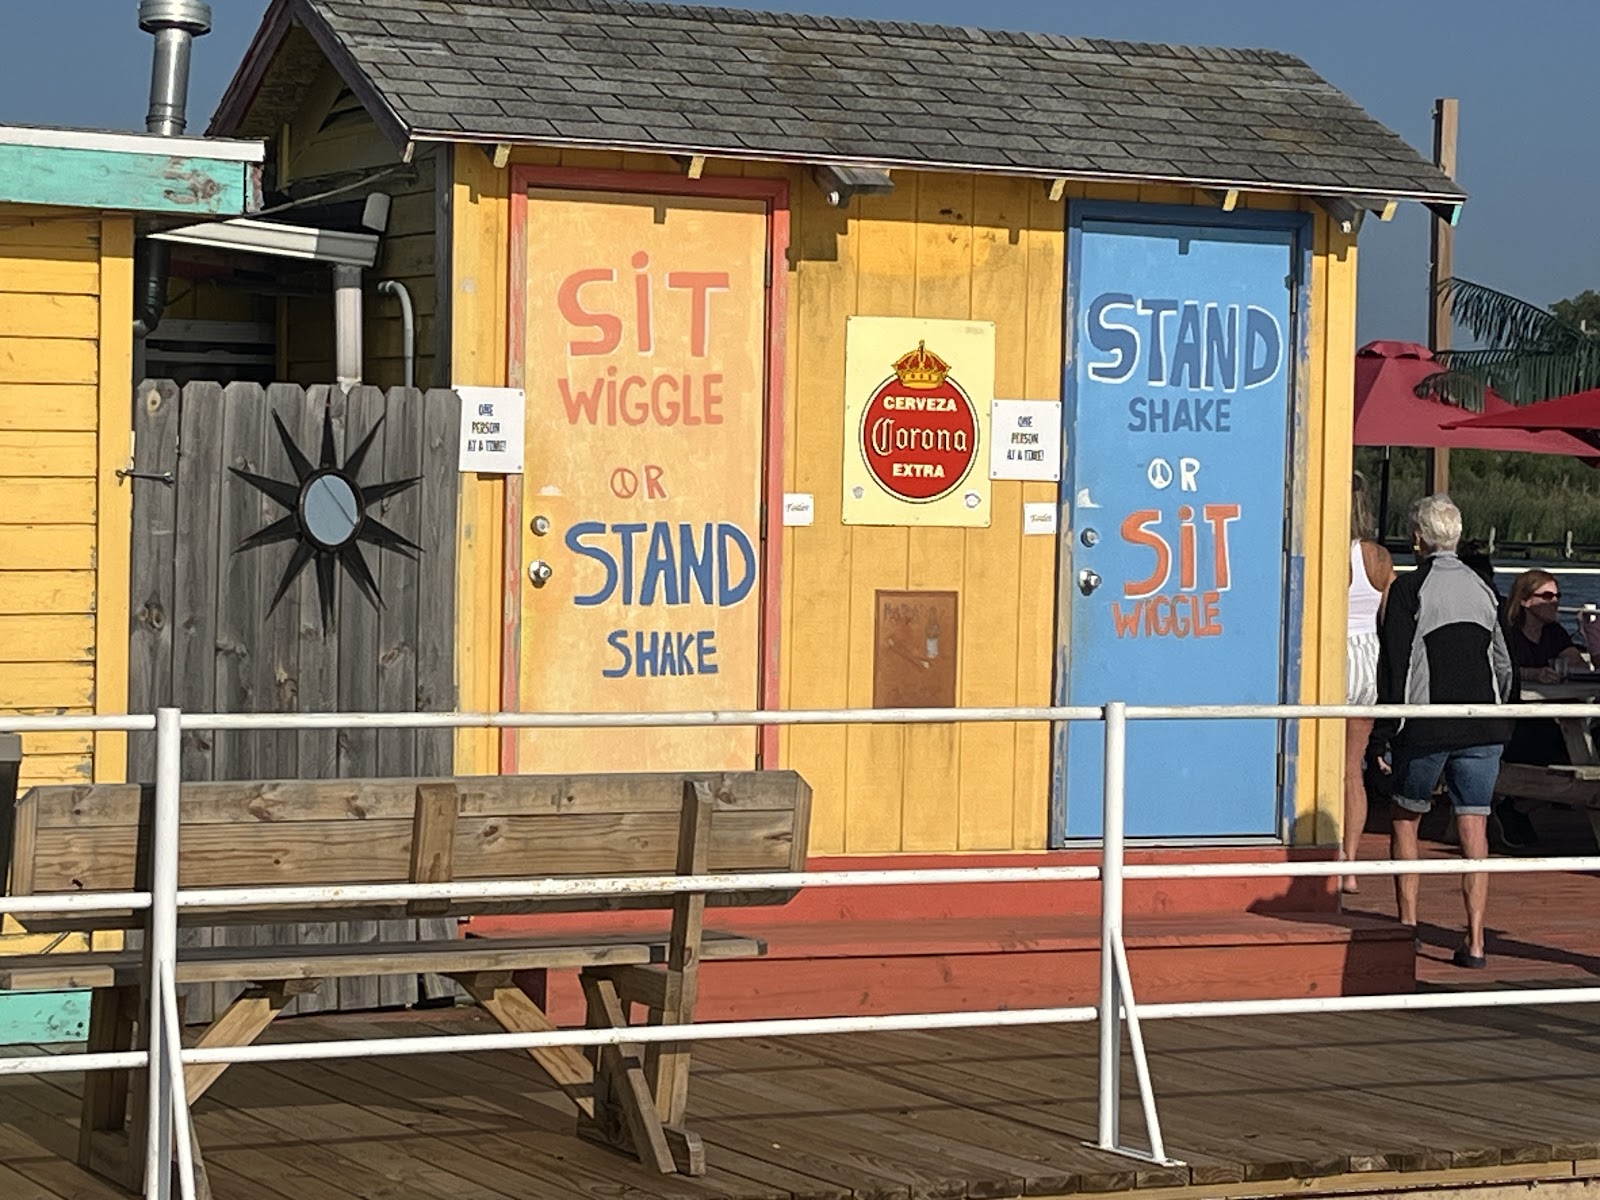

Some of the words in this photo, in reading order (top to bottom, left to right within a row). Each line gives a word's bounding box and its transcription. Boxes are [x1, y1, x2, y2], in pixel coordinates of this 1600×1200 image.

[1085, 292, 1284, 393] STAND
[883, 396, 957, 412] CERVEZA
[1128, 397, 1232, 433] SHAKE
[467, 439, 477, 452] AT
[478, 440, 484, 452] A
[871, 417, 968, 456] Corona
[1010, 432, 1039, 444] PERSON
[892, 463, 945, 478] EXTRA
[1006, 449, 1015, 461] AT
[1018, 449, 1023, 461] A
[610, 464, 668, 499] OR
[1147, 457, 1200, 492] OR
[564, 521, 757, 609] STAND
[602, 629, 719, 678] SHAKE
